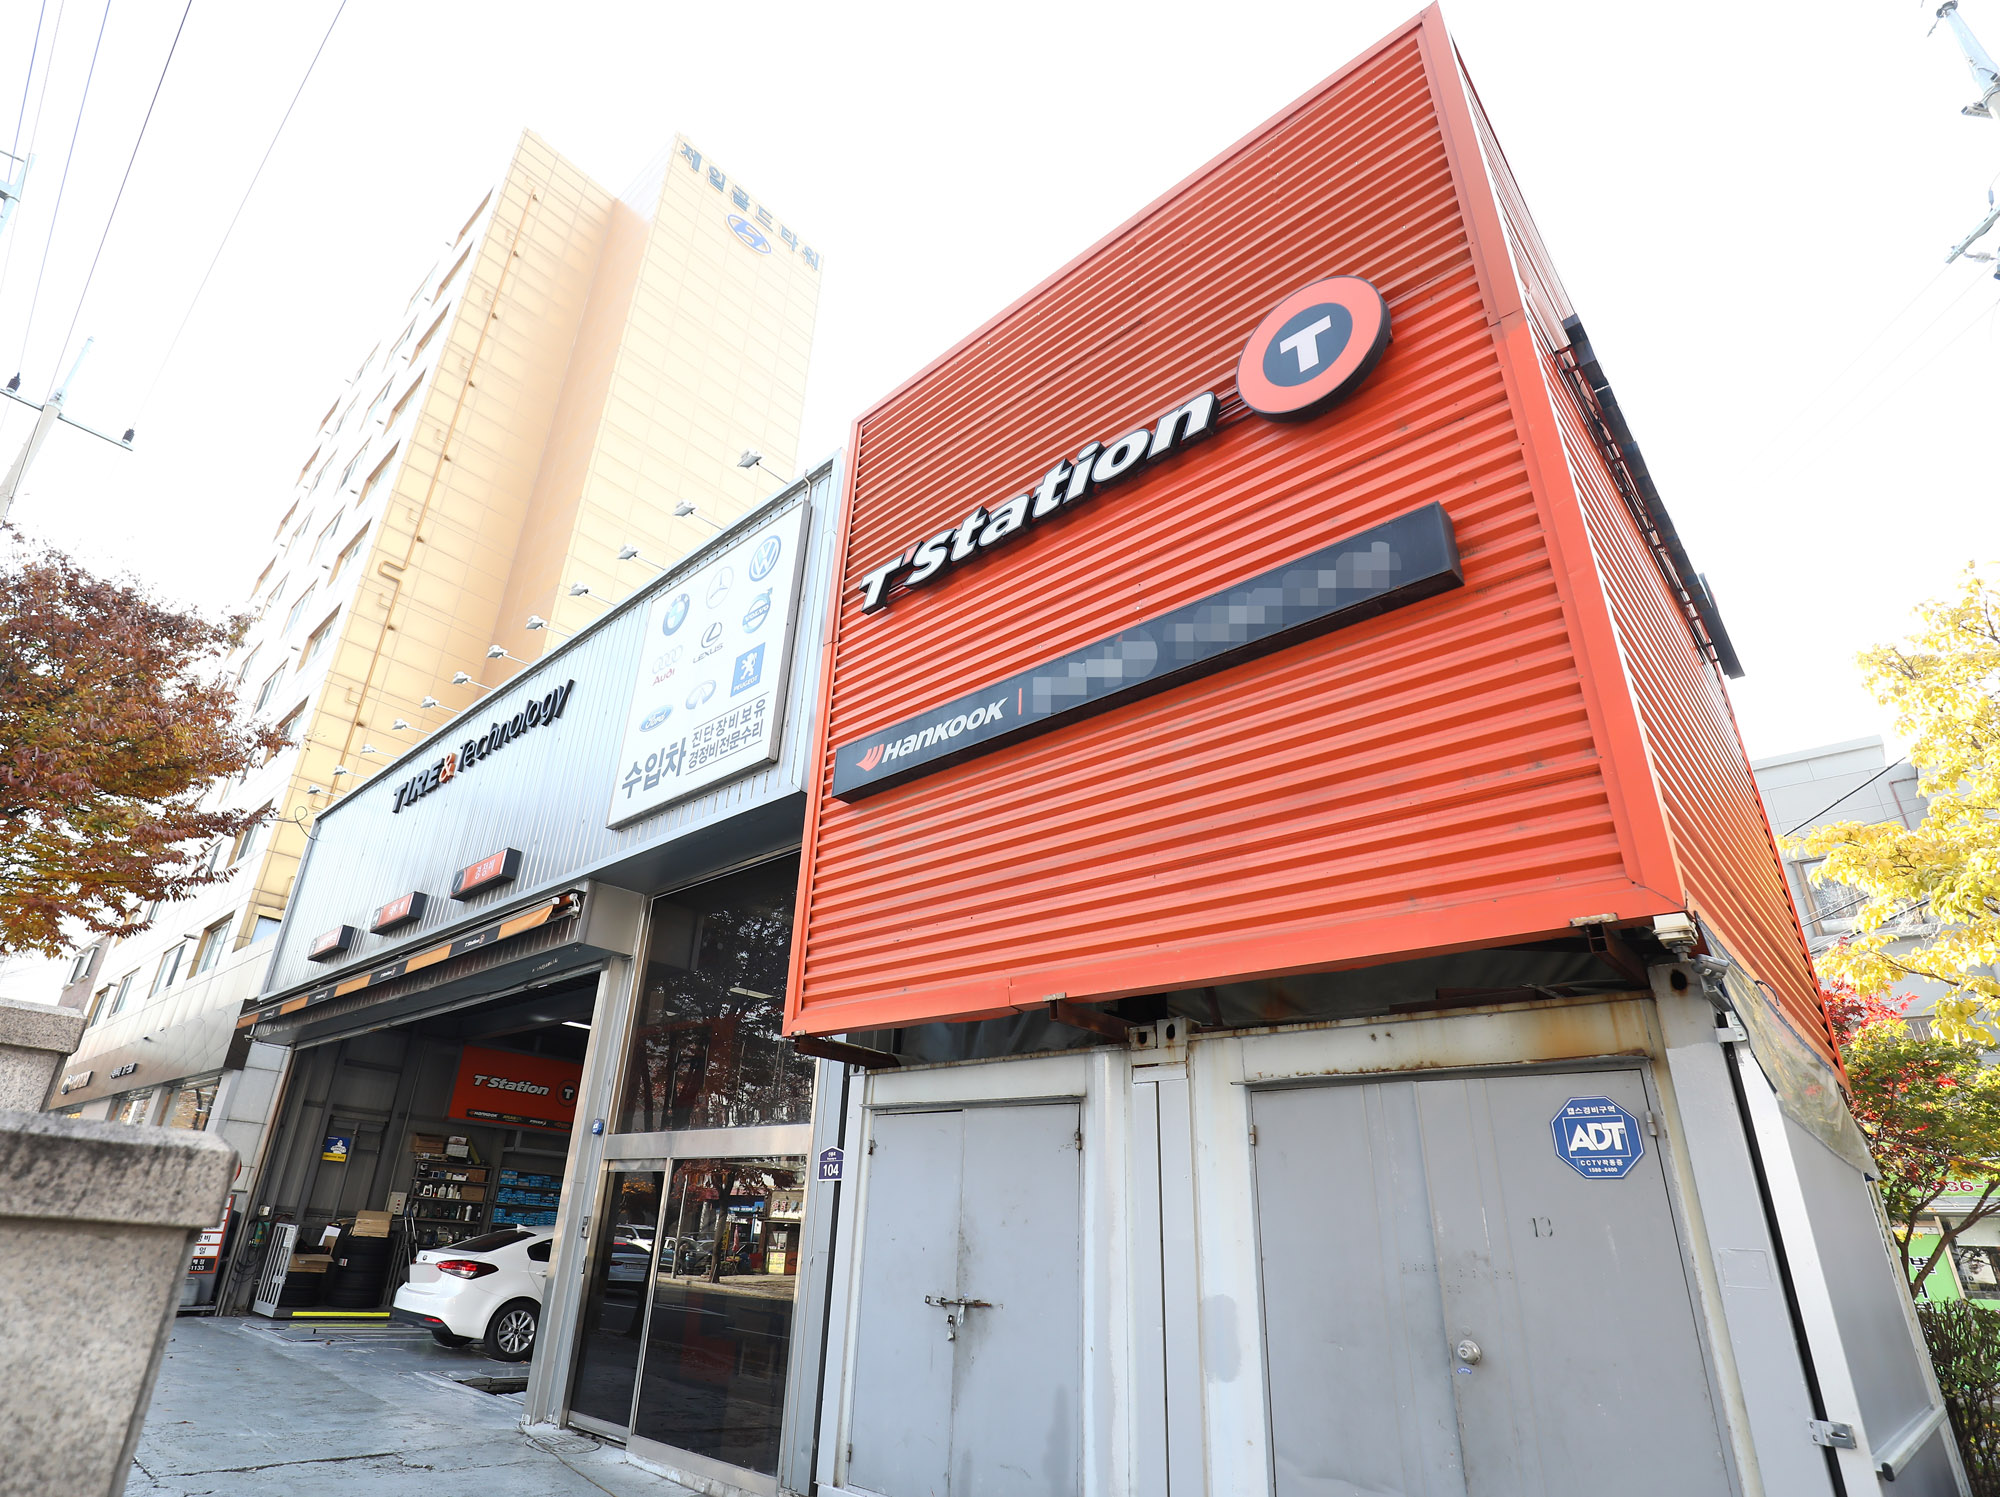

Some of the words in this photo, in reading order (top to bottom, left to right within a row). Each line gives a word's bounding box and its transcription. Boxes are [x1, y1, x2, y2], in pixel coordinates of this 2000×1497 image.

[859, 391, 1220, 615] T'Station
[693, 643, 724, 664] LEXUS
[733, 674, 760, 693] PEUGEOT
[621, 737, 688, 800] 수입차
[1569, 1122, 1625, 1152] ADT
[823, 1163, 839, 1177] 104
